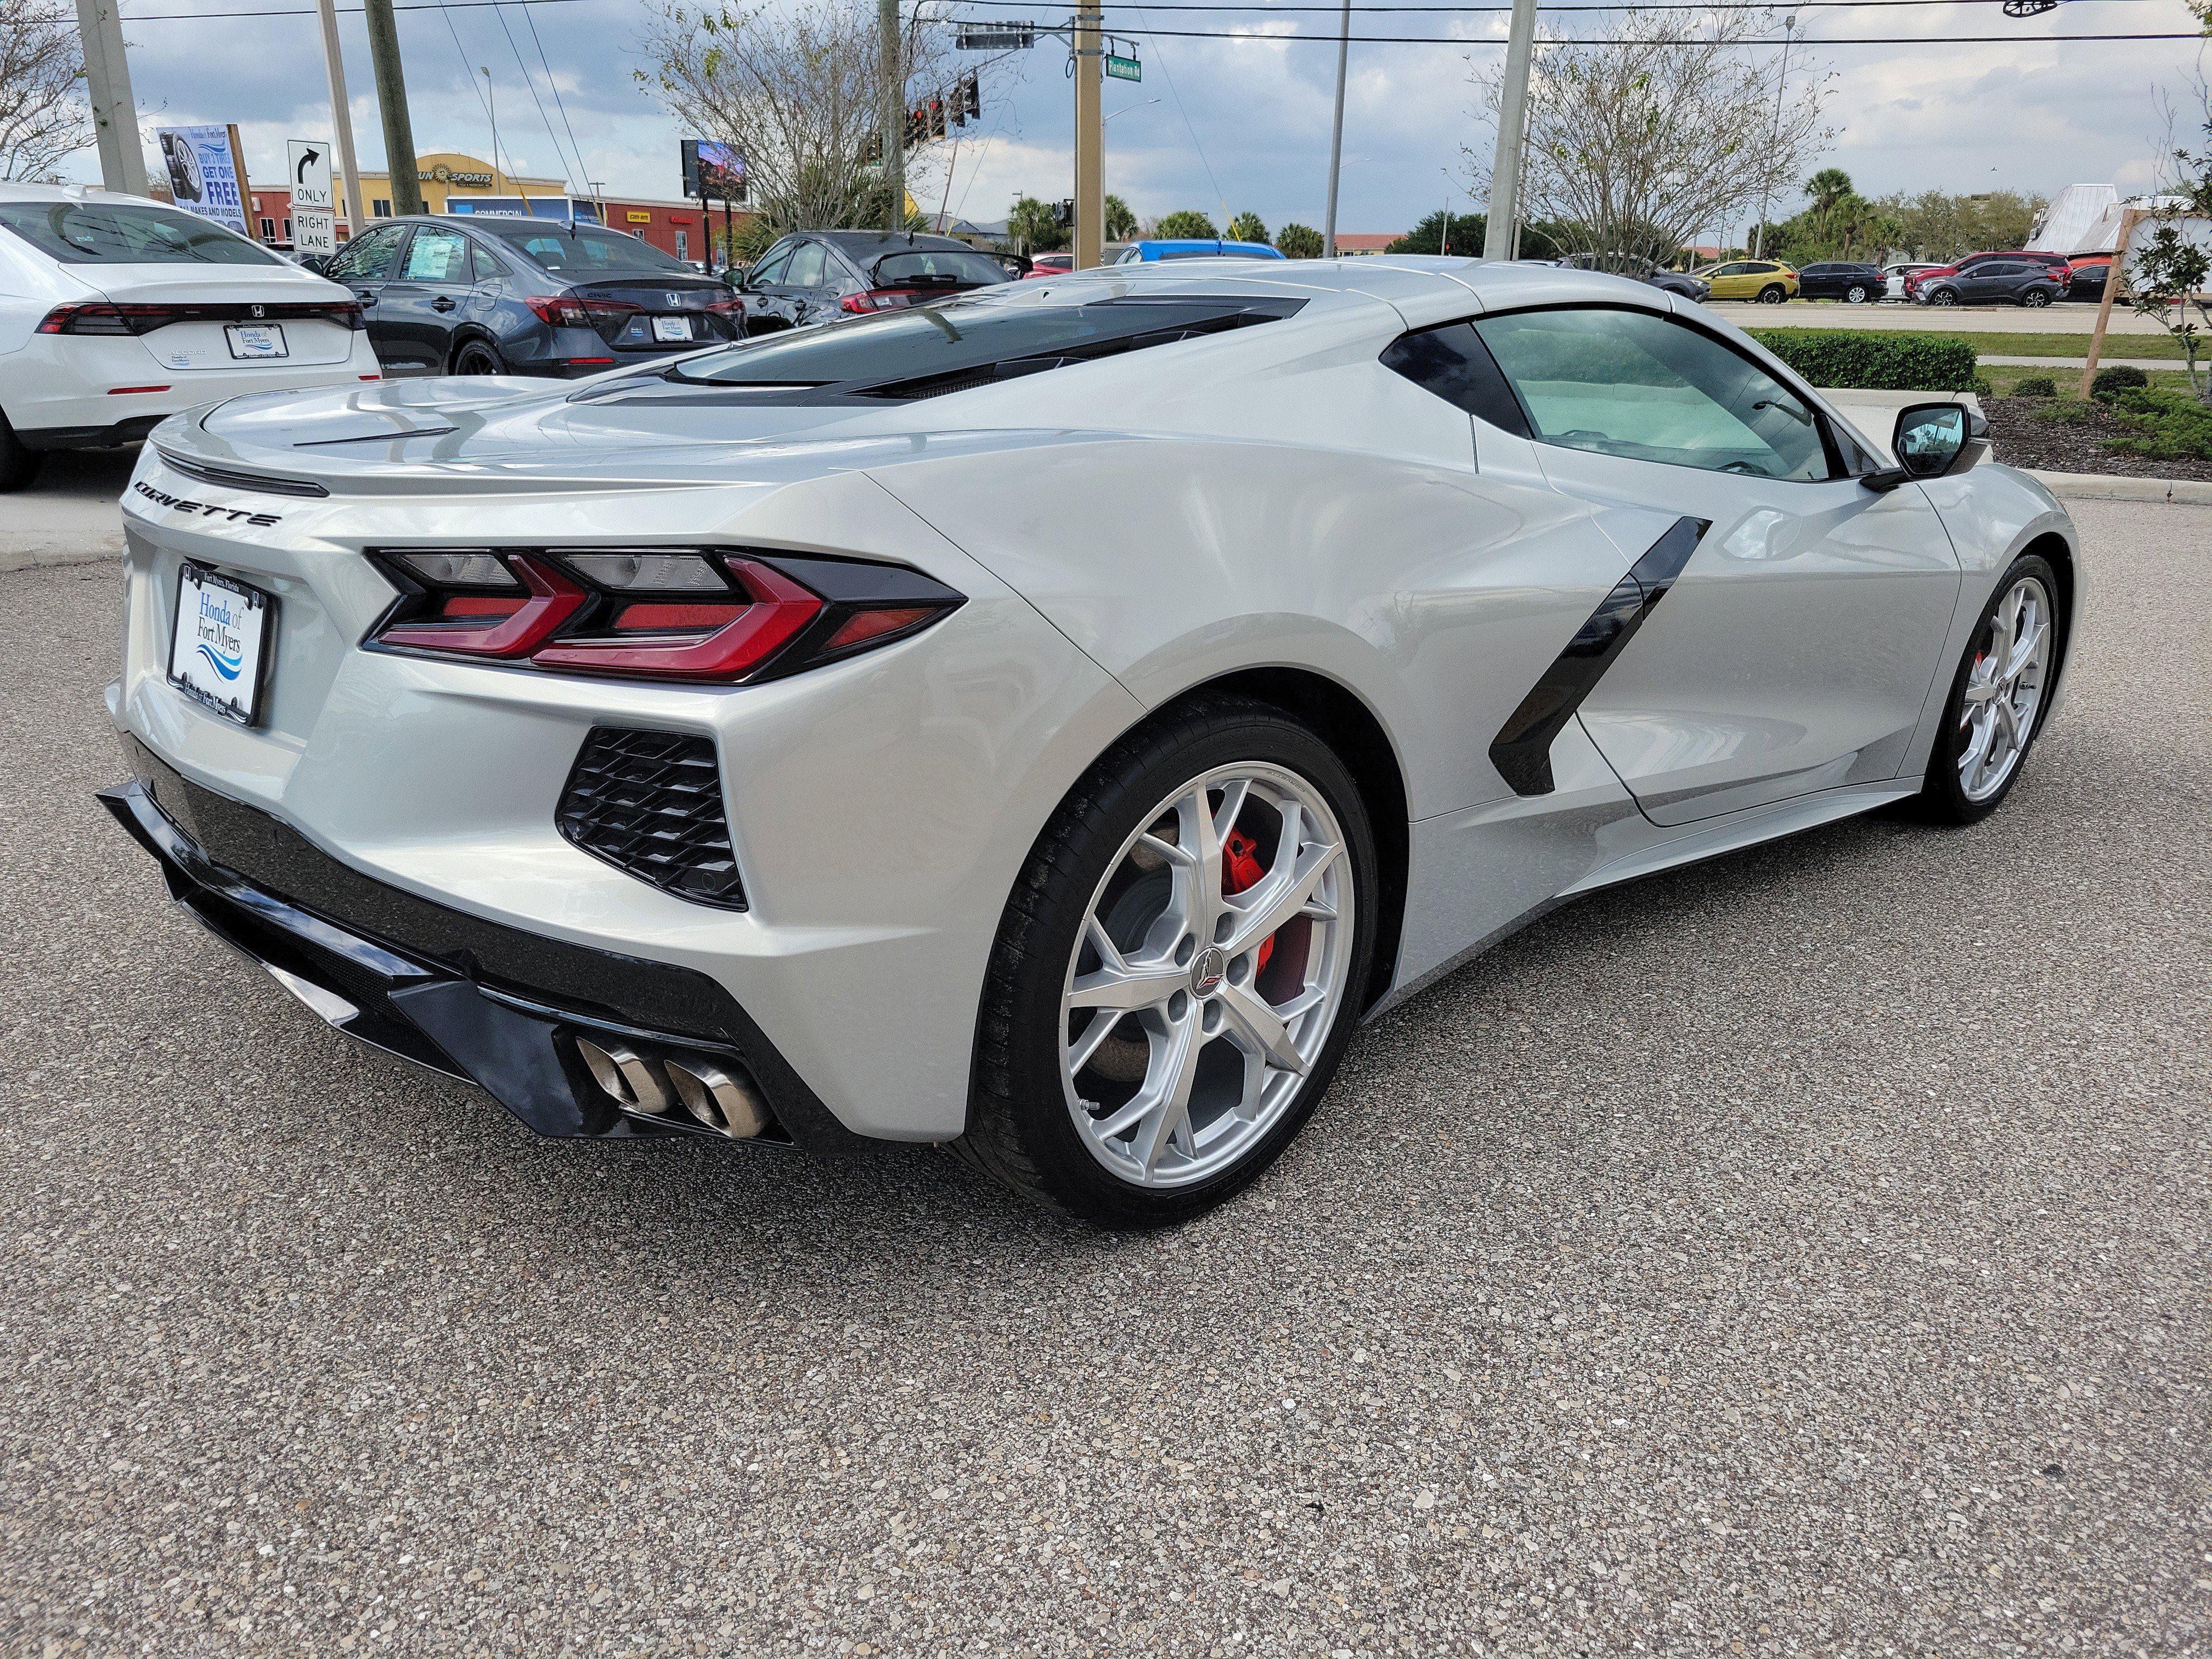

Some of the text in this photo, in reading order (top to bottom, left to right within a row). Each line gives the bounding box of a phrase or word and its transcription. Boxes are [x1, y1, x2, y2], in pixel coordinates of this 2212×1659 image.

[1109, 60, 1140, 77] Plantation Rd
[198, 153, 230, 164] BUY 3 TIRES
[203, 166, 234, 179] GET ONE
[418, 172, 493, 182] UN SPORTS
[206, 182, 239, 206] FREE
[297, 188, 327, 202] ONLY
[190, 206, 208, 216] MAKES
[208, 207, 220, 216] AND
[221, 208, 242, 218] MODELS
[298, 216, 329, 230] RIGHT
[301, 234, 329, 248] LANE
[134, 481, 283, 527] CORVETTE
[204, 572, 240, 592] Fort Myers, Florida
[199, 592, 244, 630] Honda of
[197, 616, 241, 654] Fort Myers
[185, 682, 198, 699] Honda
[202, 692, 213, 707] Fort
[1266, 771, 1305, 792] CORVETTE
